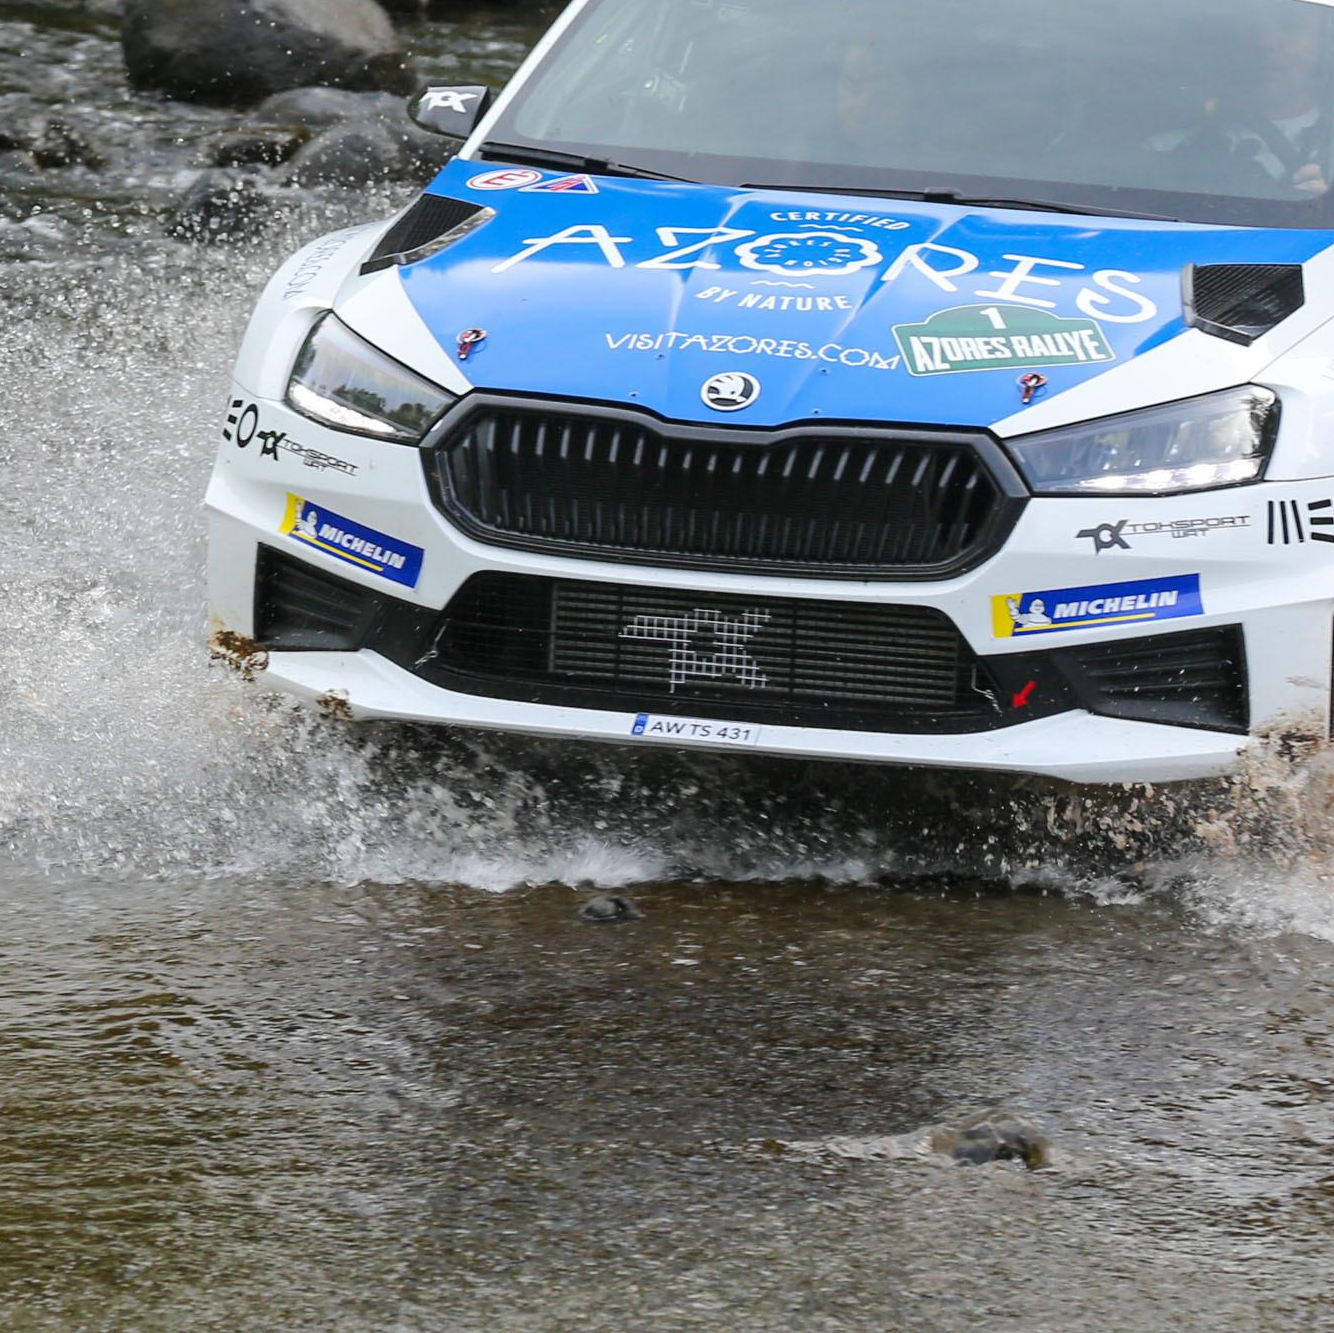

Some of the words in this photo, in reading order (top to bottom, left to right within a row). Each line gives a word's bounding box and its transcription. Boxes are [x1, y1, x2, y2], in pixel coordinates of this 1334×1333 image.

[769, 211, 912, 231] CERTIFIED
[490, 223, 1158, 324] AZORES
[695, 285, 739, 303] BY
[738, 293, 853, 312] NATURE
[979, 307, 1007, 330] 1
[605, 331, 902, 371] VISITAZORES.COM
[909, 335, 1012, 373] AZORES
[1010, 329, 1107, 362] RALLYE
[318, 523, 406, 570] MICHELIN
[1053, 589, 1179, 619] MICHELIN
[650, 720, 686, 735] AW
[691, 723, 711, 738] TS
[716, 727, 751, 741] 431
